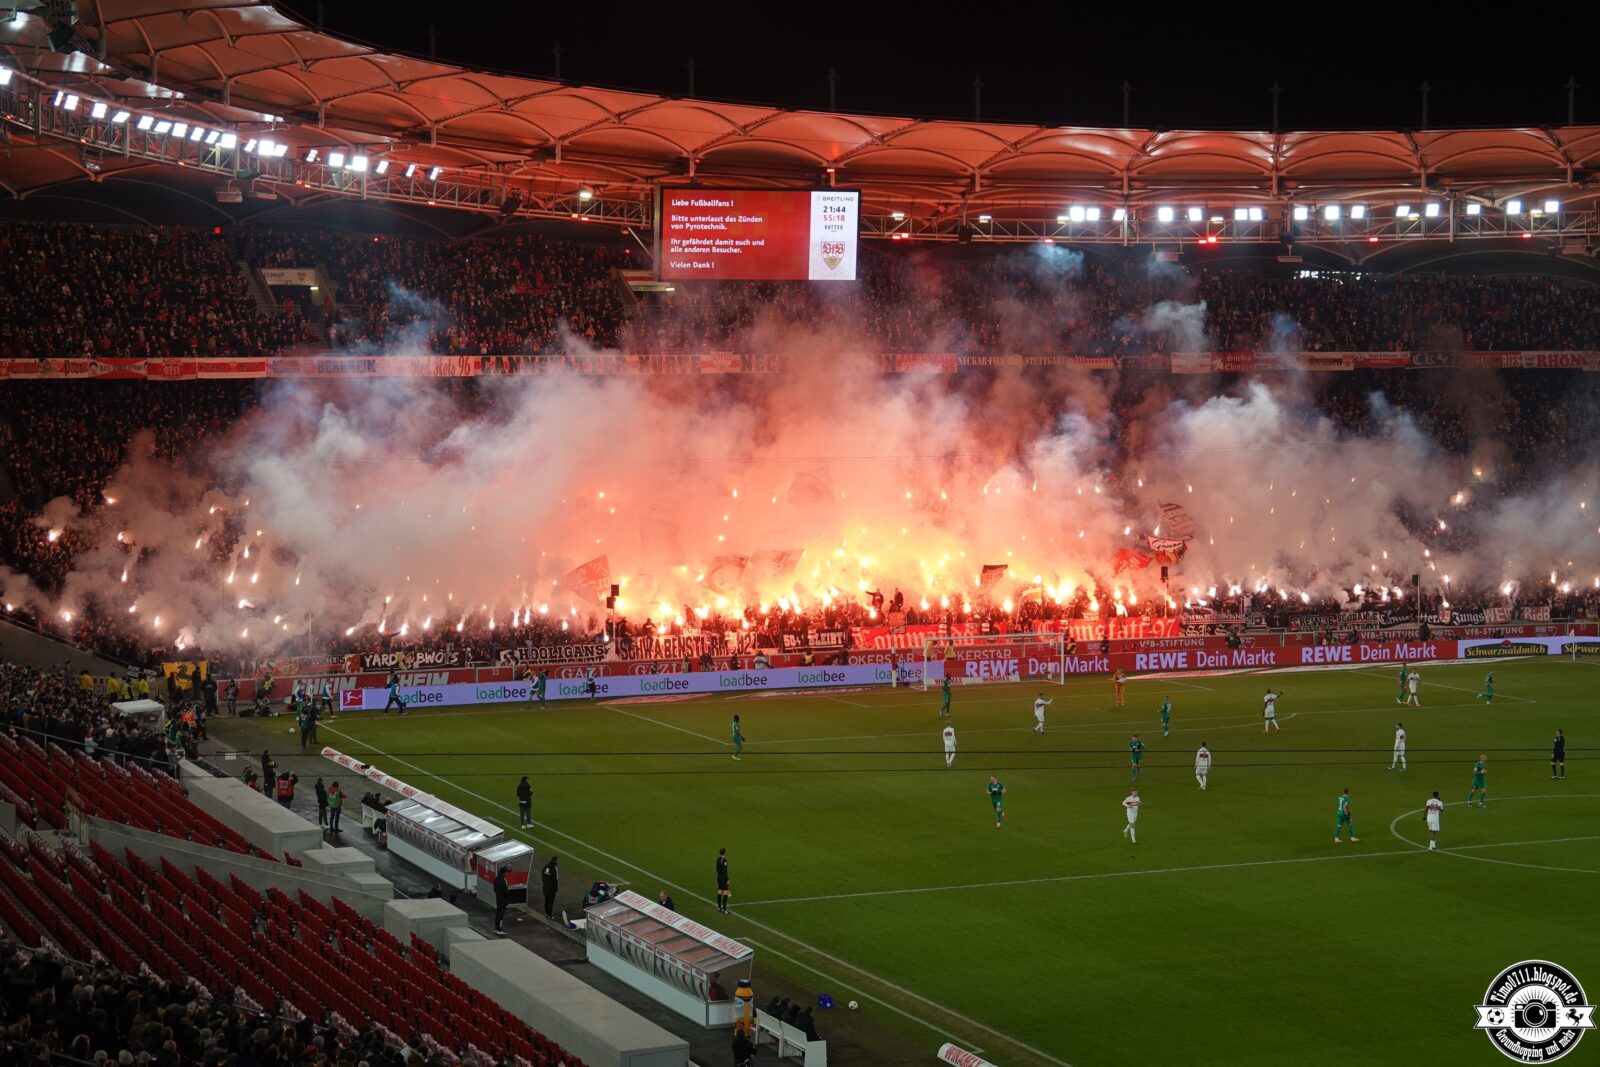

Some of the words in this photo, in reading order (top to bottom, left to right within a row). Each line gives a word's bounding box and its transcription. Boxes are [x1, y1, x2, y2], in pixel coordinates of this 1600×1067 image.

[823, 205, 846, 213] 21:44
[671, 214, 689, 222] Bitte
[738, 215, 763, 223] Zünden
[823, 214, 846, 222] 55:18
[685, 223, 728, 231] Pyrotechnik.
[682, 238, 713, 247] gefährdet
[670, 261, 691, 269] Vielen
[692, 261, 711, 269] Dank
[1451, 611, 1485, 625] Jungs
[518, 644, 604, 660] HOOLIGANS
[1302, 646, 1352, 663] REWE
[1360, 644, 1390, 660] Dein
[1395, 642, 1437, 660] Markt
[1466, 644, 1546, 657] Schwarzwaldmilch
[364, 653, 398, 667] YARD
[965, 659, 1019, 677] REWE
[1028, 658, 1060, 675] Dein
[1065, 656, 1109, 672] Markt
[1135, 652, 1188, 670] REWE
[1197, 651, 1228, 667] Dein
[1232, 650, 1276, 666] Markt
[719, 671, 768, 687] loadbee
[798, 670, 846, 684] loadbee
[640, 678, 689, 692] loadbee
[399, 690, 443, 704] oadbee
[476, 686, 527, 700] loadbee
